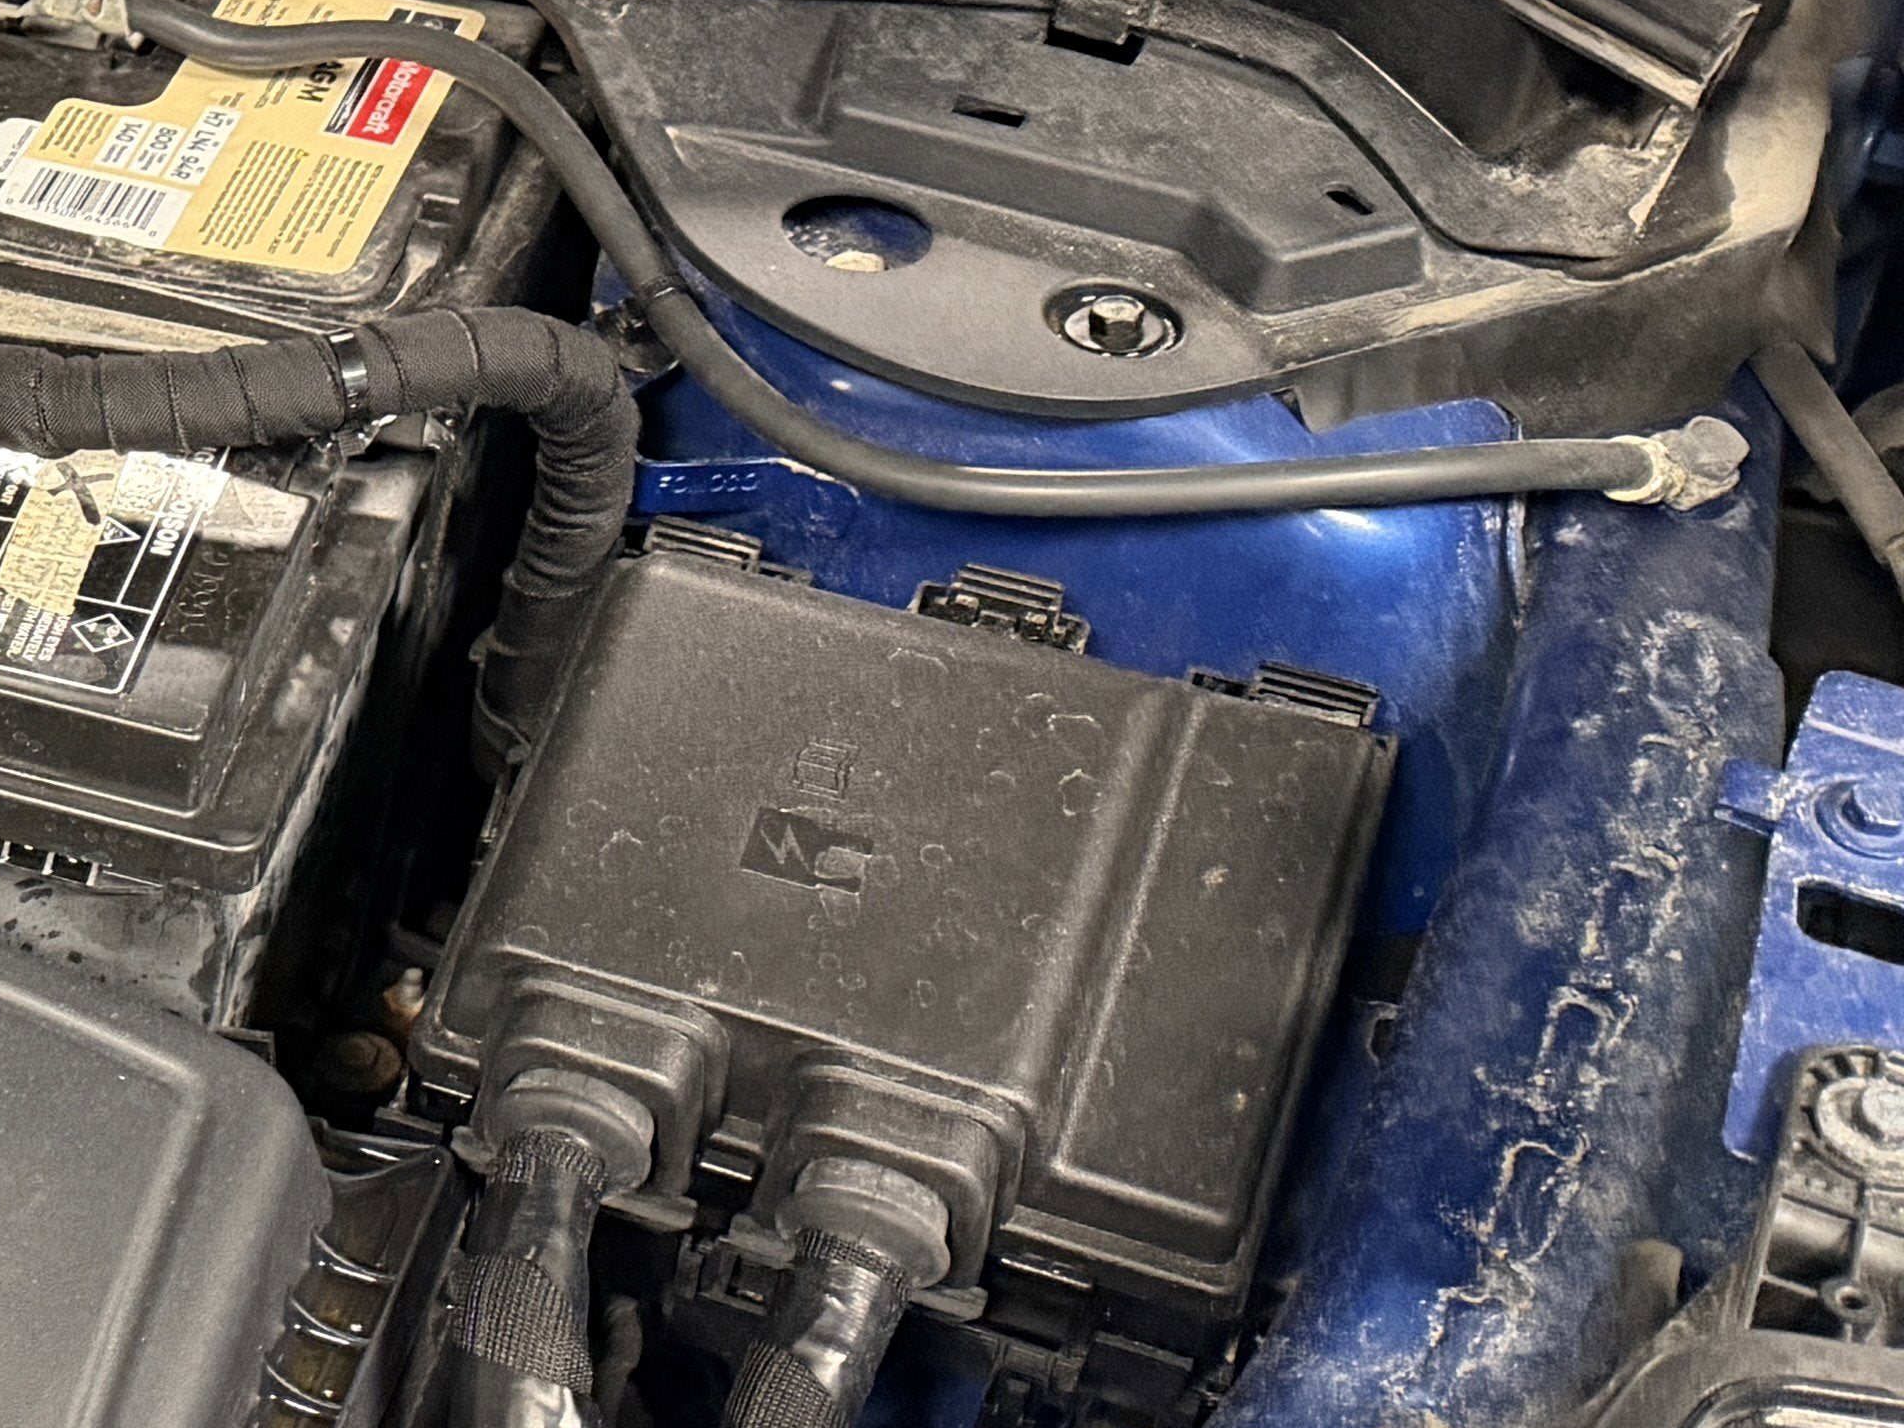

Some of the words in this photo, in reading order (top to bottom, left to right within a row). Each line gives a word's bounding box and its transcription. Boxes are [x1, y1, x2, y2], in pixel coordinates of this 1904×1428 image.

[204, 111, 227, 128] H7
[115, 123, 143, 142] 140
[150, 127, 178, 150] 800
[188, 130, 216, 152] LN4
[170, 155, 200, 180] 94R
[0, 484, 18, 505] OUT
[38, 636, 60, 662] EYES
